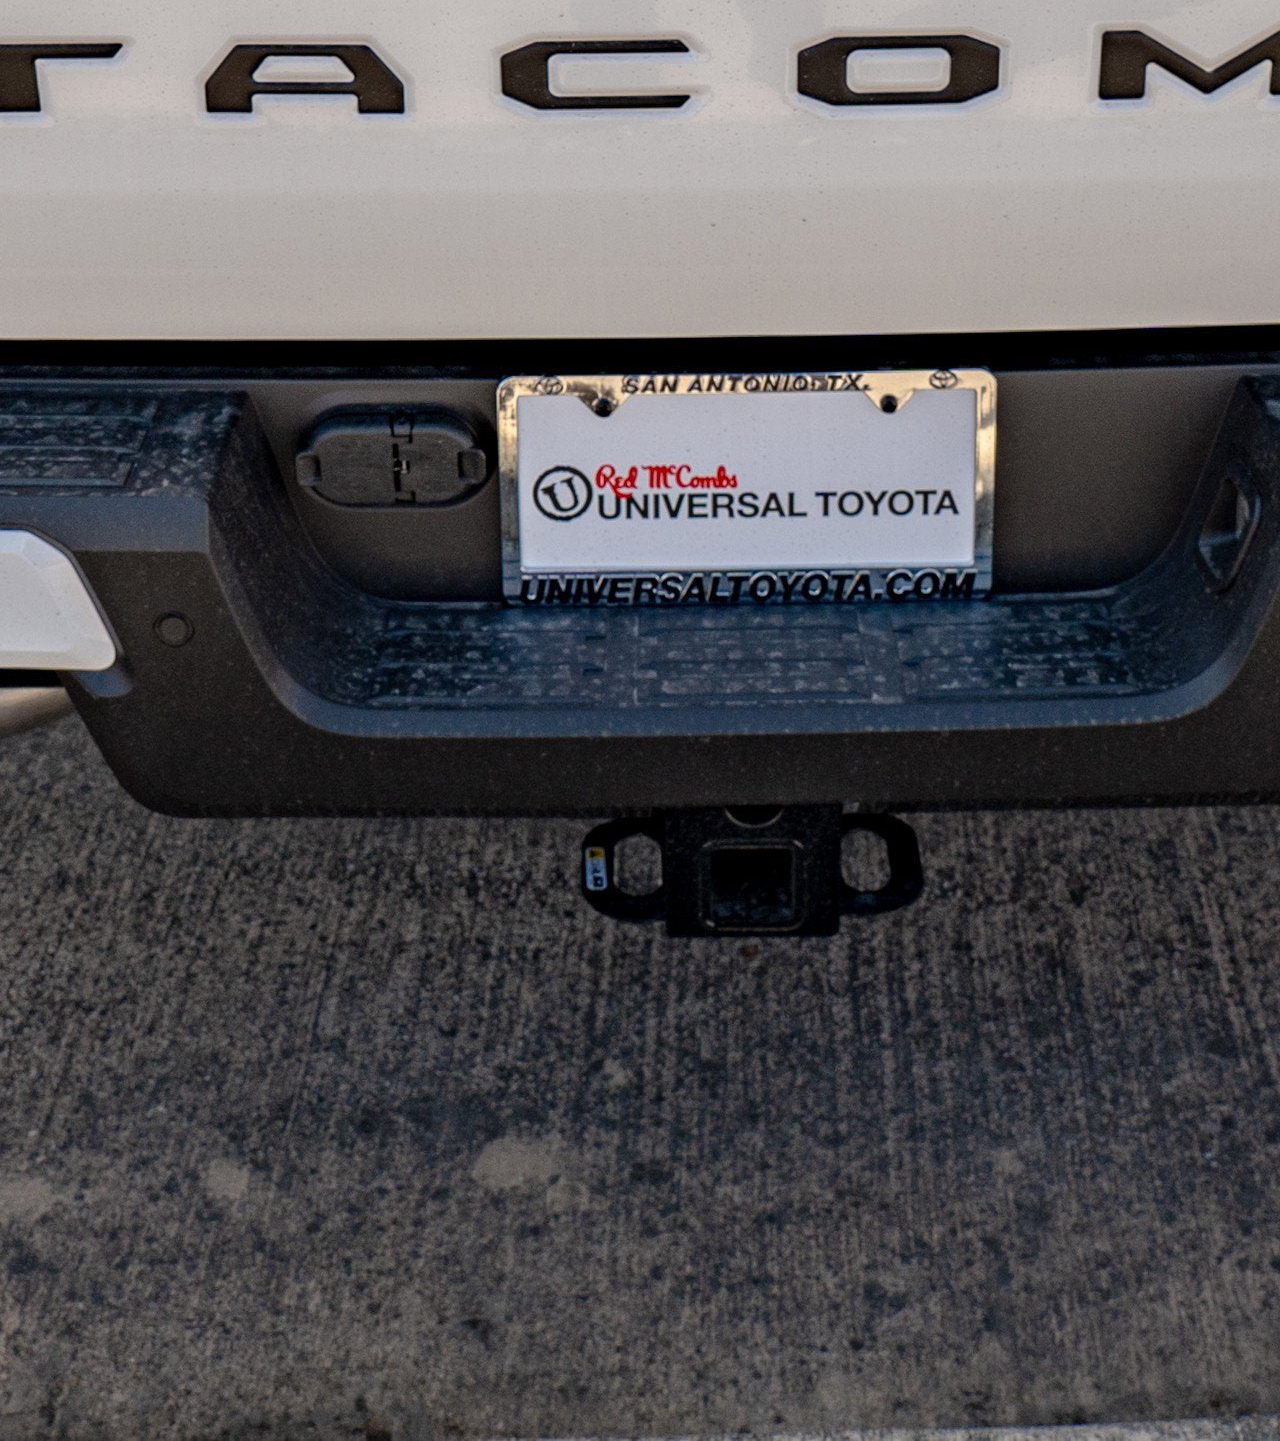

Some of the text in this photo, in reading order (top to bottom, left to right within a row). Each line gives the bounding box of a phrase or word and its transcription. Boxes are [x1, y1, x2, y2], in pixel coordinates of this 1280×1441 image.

[621, 375, 678, 394] SAN
[595, 464, 739, 498] Red McCombs
[598, 489, 960, 520] UNIVERSAL TOYOTA
[519, 569, 978, 606] UNIVERSALTOYOTA.COM
